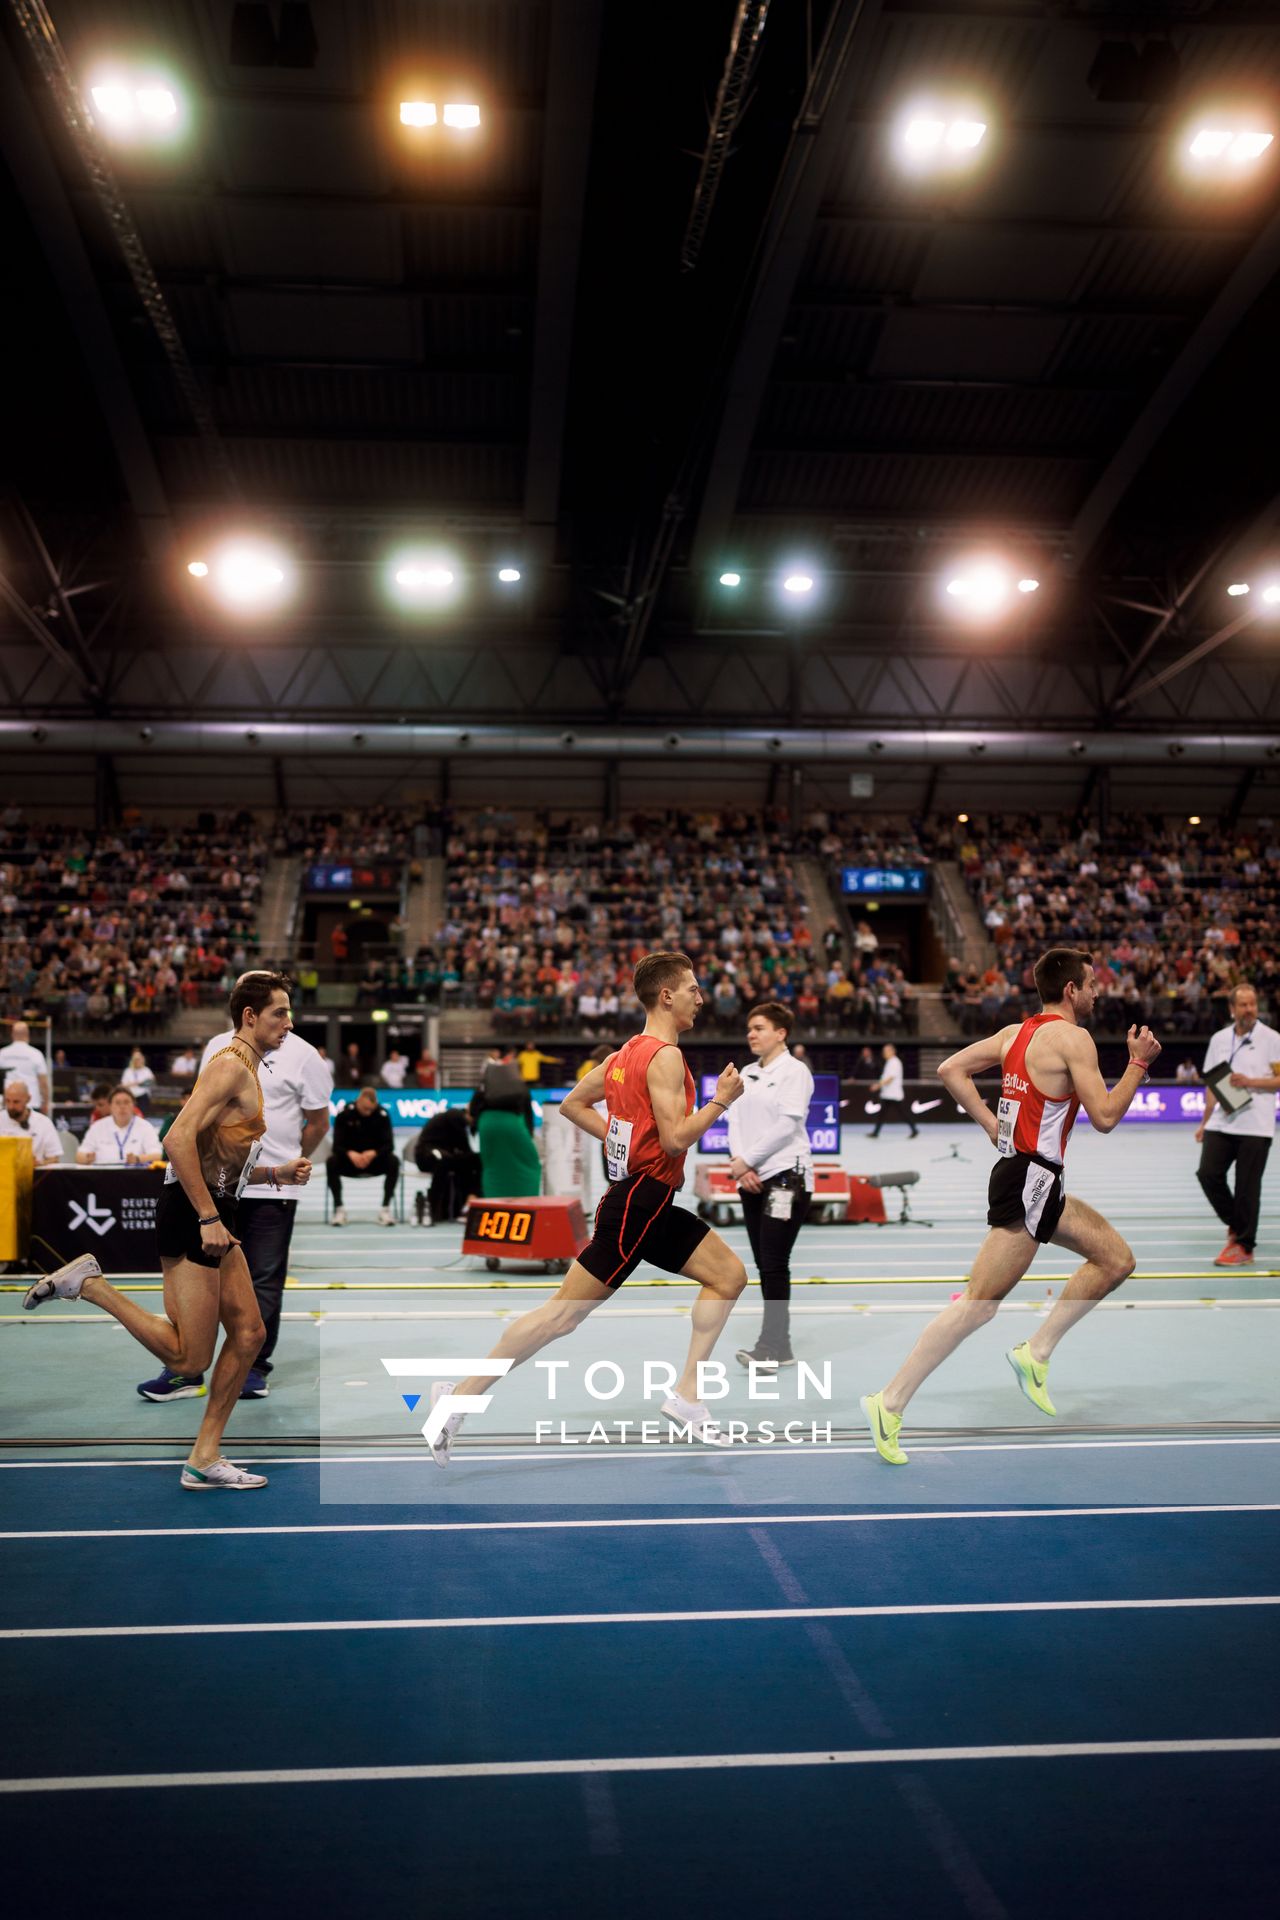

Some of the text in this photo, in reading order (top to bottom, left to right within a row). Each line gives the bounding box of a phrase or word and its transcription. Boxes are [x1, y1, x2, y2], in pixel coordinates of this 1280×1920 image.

[1127, 1092, 1166, 1111] LS.
[824, 1104, 837, 1124] 1
[121, 1198, 158, 1208] DEUTS
[477, 1211, 532, 1241] 1:00
